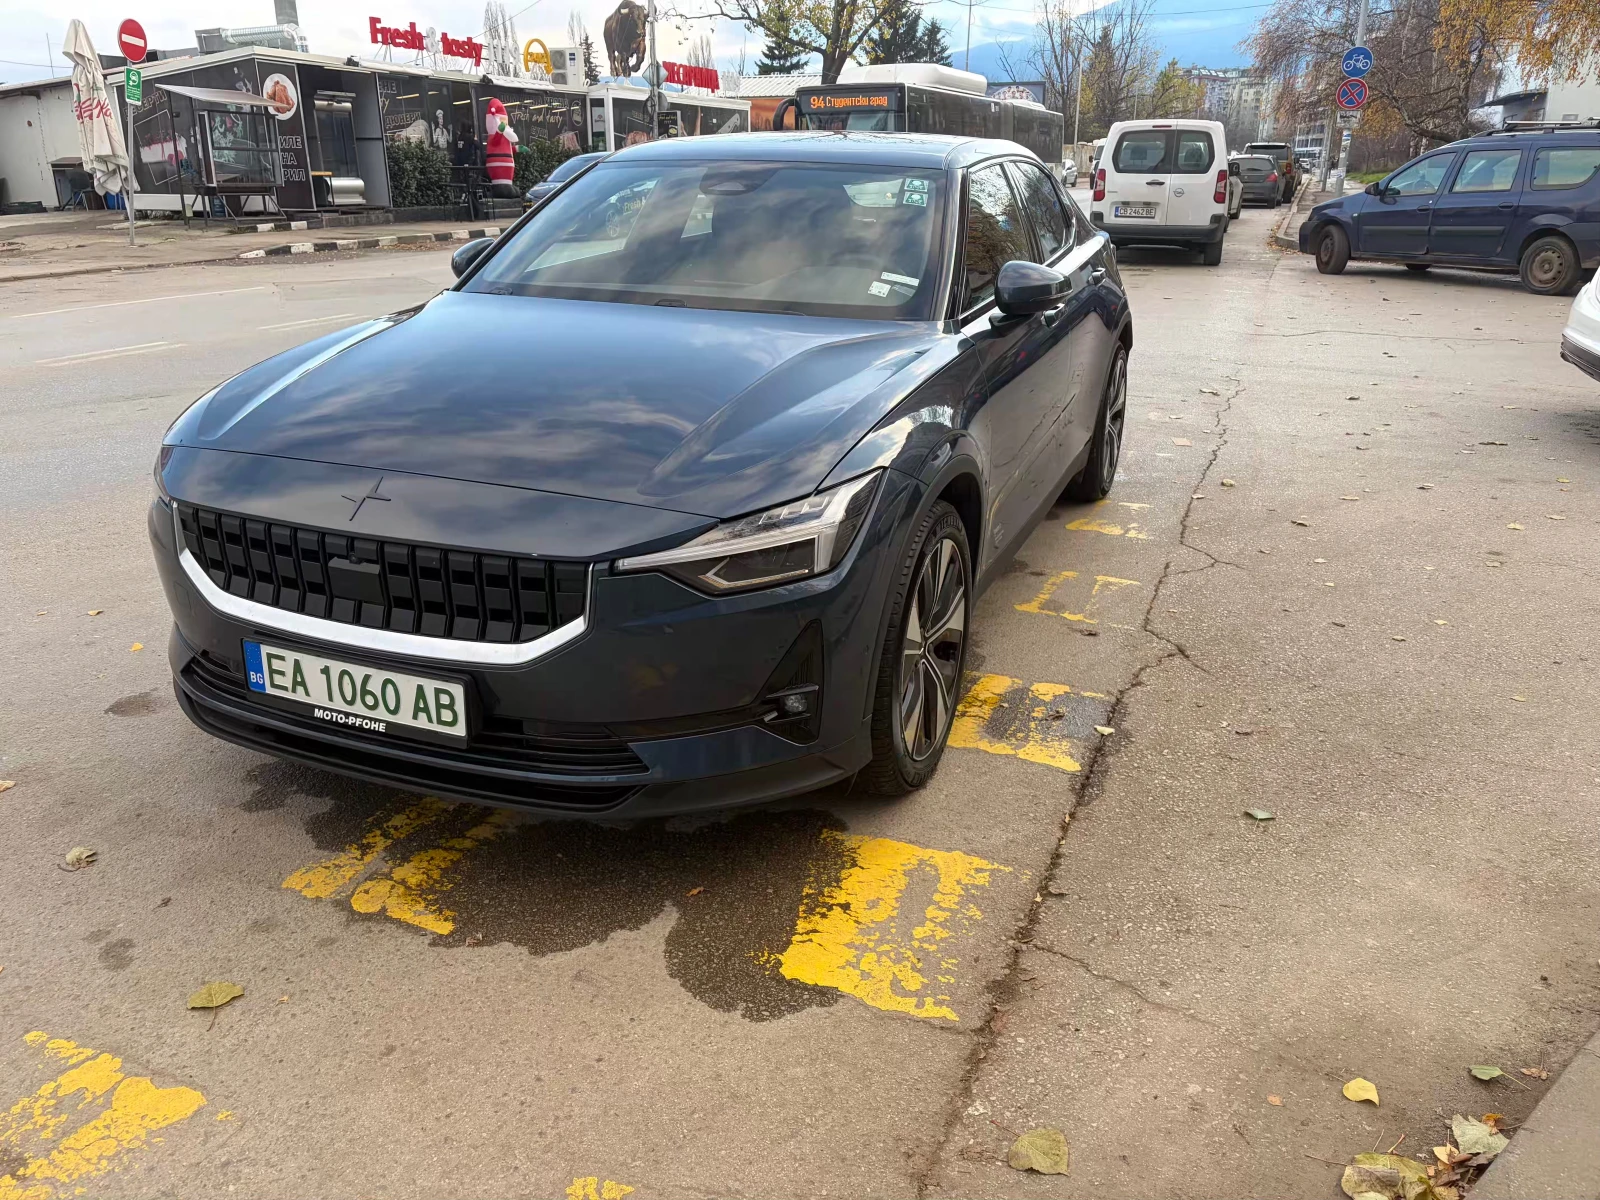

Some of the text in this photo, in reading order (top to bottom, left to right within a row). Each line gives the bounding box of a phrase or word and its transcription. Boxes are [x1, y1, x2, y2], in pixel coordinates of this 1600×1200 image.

[369, 16, 424, 50] Fresh
[425, 27, 440, 54] &
[441, 32, 483, 67] tasty
[811, 96, 825, 109] 94
[279, 136, 302, 148] ИЛЕ
[281, 152, 297, 164] НА
[283, 169, 305, 181] РИЛ
[250, 671, 264, 684] BG
[266, 652, 459, 728] EA 1060 AB
[314, 708, 387, 733] MOTO-PFOHE
